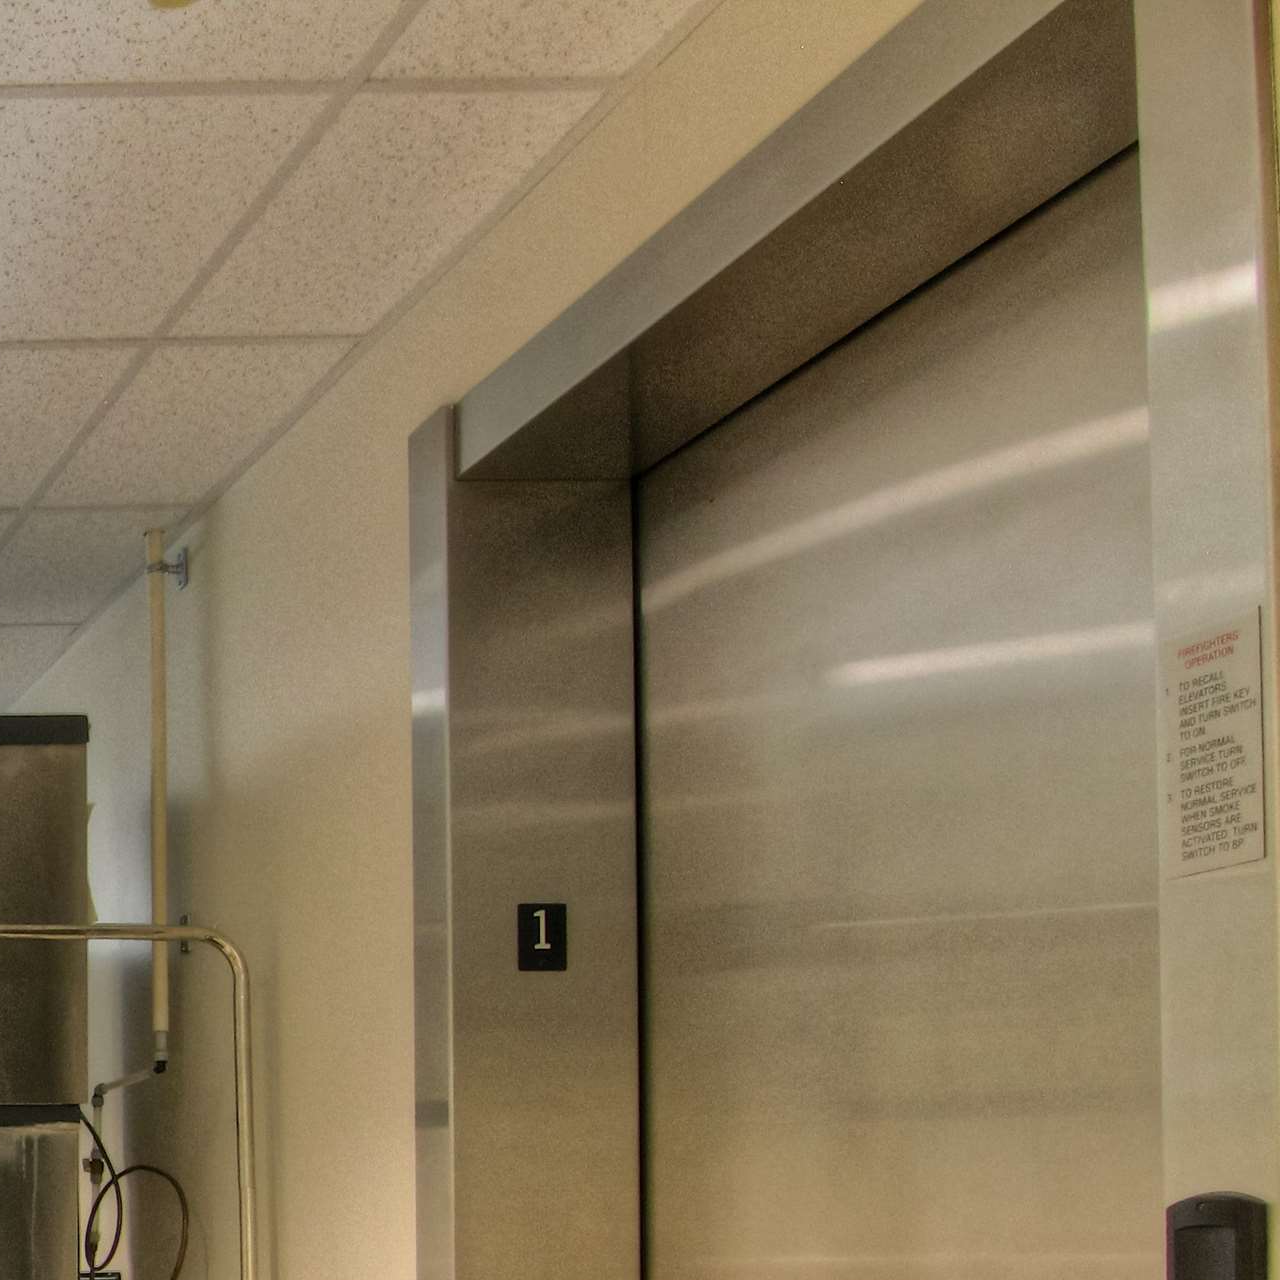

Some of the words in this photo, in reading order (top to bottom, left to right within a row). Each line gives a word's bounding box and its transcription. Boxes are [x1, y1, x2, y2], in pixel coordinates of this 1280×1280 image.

[1184, 646, 1233, 669] OPERATION
[1179, 681, 1190, 691] TO
[1192, 671, 1224, 687] RECALL
[1178, 681, 1227, 705] ELEVATORS
[1180, 699, 1209, 717] INSERT
[1212, 693, 1231, 705] FIRE
[1233, 686, 1250, 699] KEY
[1180, 716, 1196, 728] AND
[1199, 709, 1221, 722] TURN
[1223, 698, 1257, 716] SWITCH
[1180, 730, 1191, 740] TO
[1192, 726, 1206, 738] ON
[1180, 746, 1196, 758] FOR
[1198, 736, 1235, 752] NORMAL
[1180, 752, 1216, 770] SERVICE
[1218, 745, 1243, 759] TURN
[1180, 766, 1213, 782] SWITCH
[1216, 761, 1227, 772] TO
[1230, 756, 1246, 770] OFF
[1181, 788, 1192, 799] TO
[1194, 777, 1233, 795] RESTORE
[1181, 795, 1216, 811] NORMAL
[1220, 783, 1257, 801] SERVICE
[1182, 809, 1207, 823] WHEN
[1209, 800, 1240, 816] SMOKE
[1181, 818, 1221, 836] SENSORS
[1225, 813, 1241, 824] ARE
[1182, 830, 1227, 848] ACTIVATED
[1182, 846, 1215, 860] SWITCH
[1219, 841, 1229, 851] TO
[533, 909, 551, 950] 1
